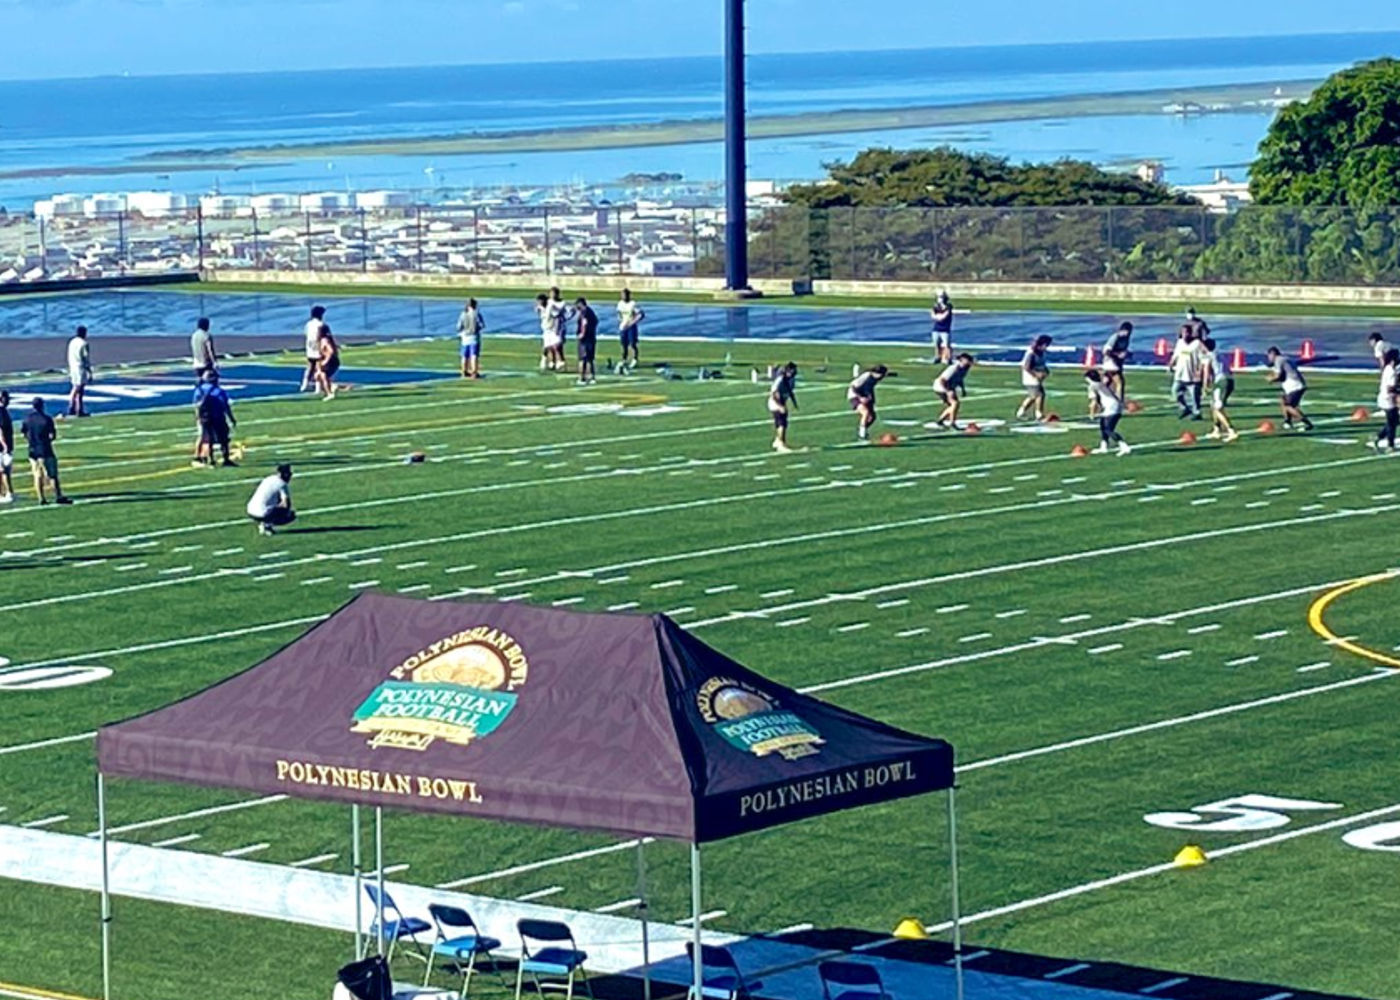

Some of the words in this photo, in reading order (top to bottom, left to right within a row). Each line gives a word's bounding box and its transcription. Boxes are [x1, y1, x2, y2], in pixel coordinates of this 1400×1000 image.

[389, 626, 514, 680] POLYNESIAN
[502, 644, 529, 691] BOWL
[373, 703, 482, 728] FOOTBALL
[375, 688, 508, 716] POLYNESIAN
[276, 759, 412, 795] POLYNESIAN
[417, 776, 483, 803] BOWL
[739, 771, 859, 817] POLYNESIAN
[864, 760, 917, 788] BOWL
